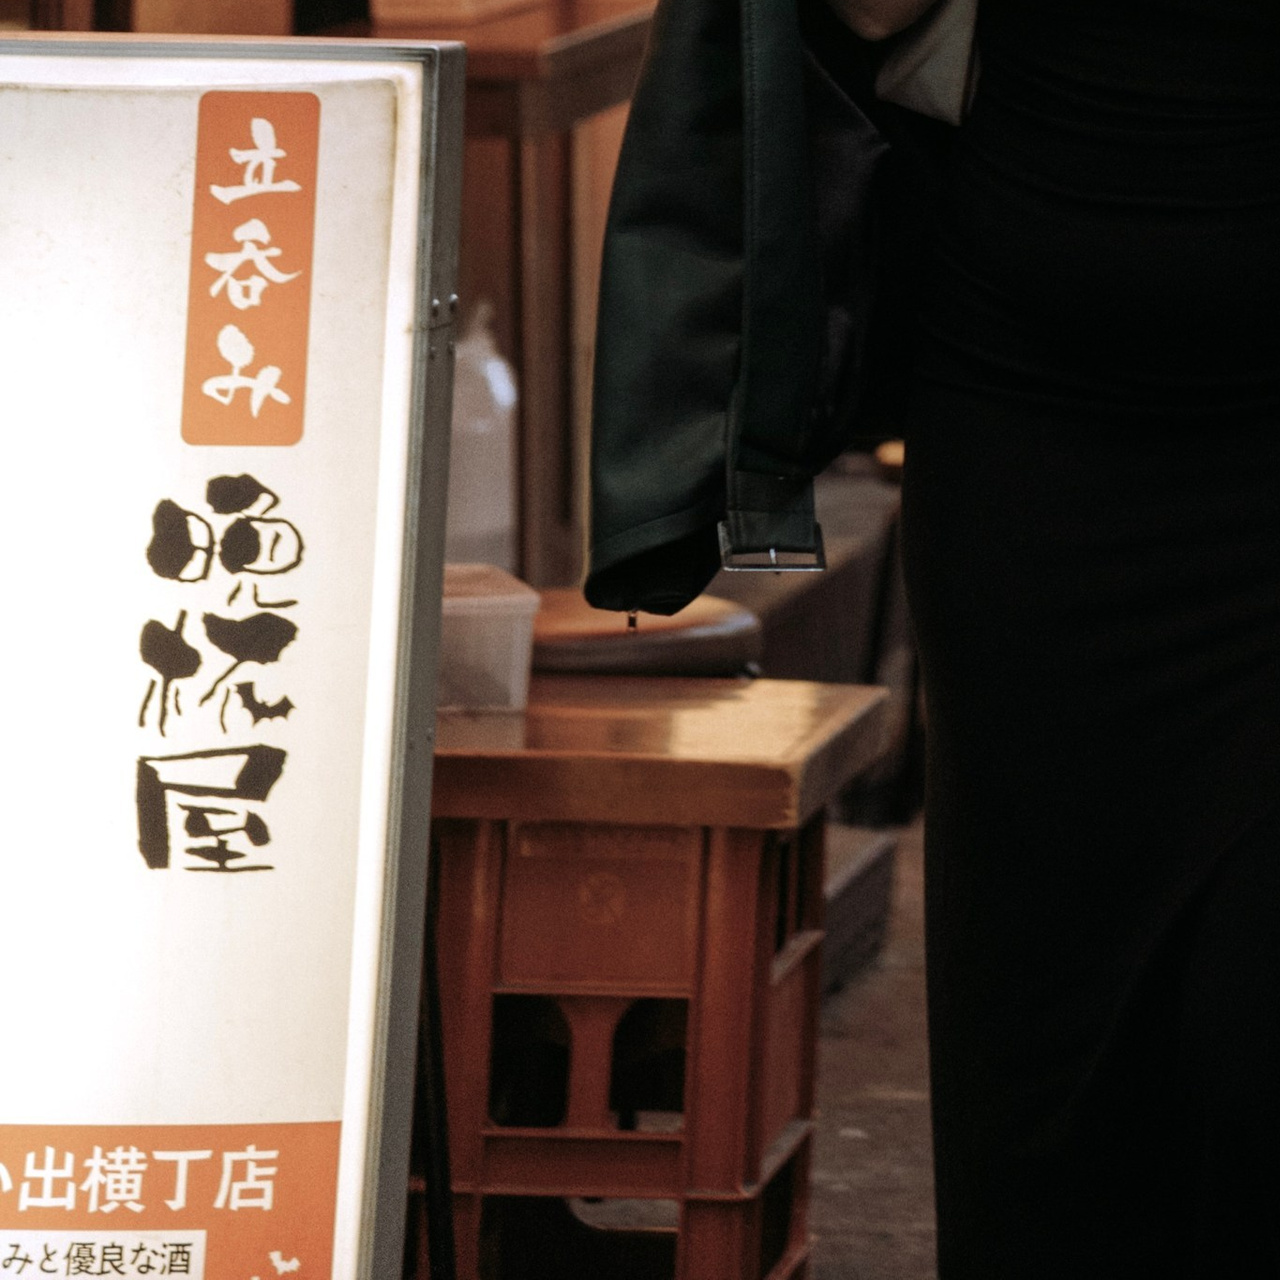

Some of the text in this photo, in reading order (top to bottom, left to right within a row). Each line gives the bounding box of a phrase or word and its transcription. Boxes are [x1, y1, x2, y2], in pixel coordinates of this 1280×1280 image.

[202, 117, 303, 418] 立呑み
[136, 473, 305, 872] 晩杯屋
[1, 1240, 194, 1277] みと優良な酒
